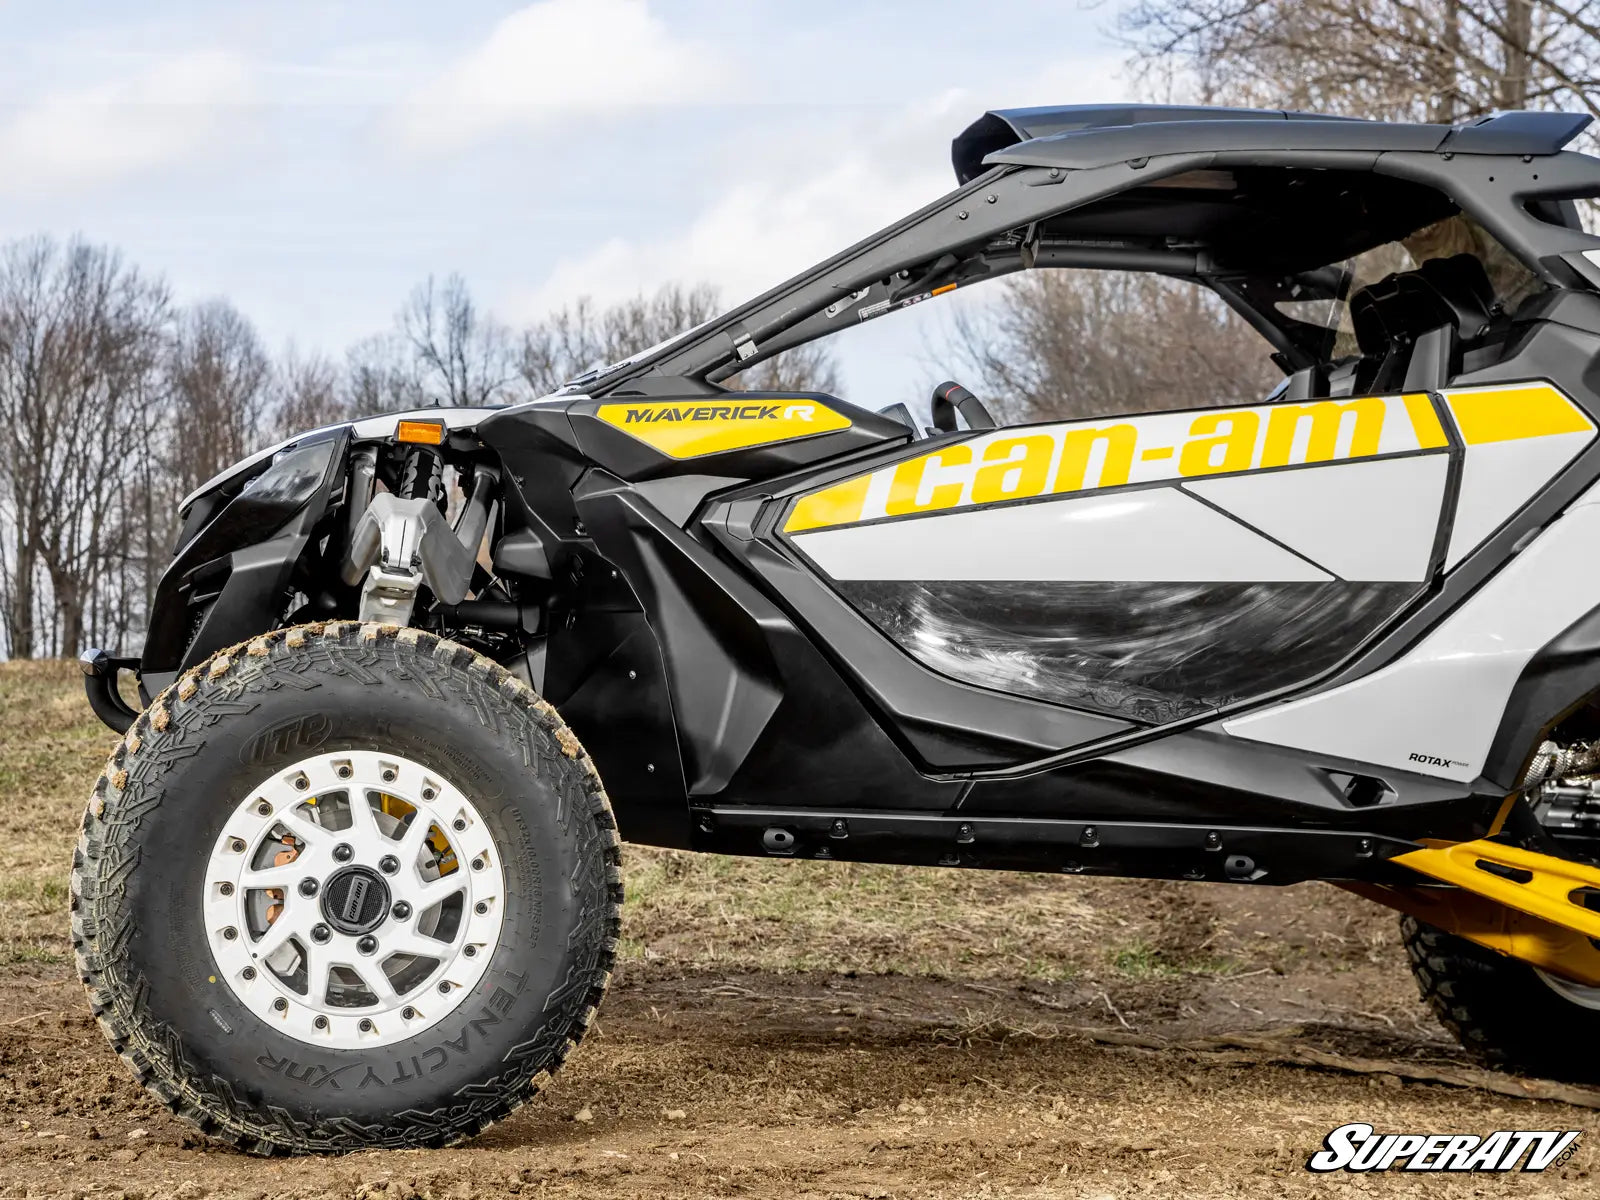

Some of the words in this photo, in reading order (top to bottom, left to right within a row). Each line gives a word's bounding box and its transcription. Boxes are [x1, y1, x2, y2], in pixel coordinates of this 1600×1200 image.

[625, 405, 783, 424] MAVERICK
[784, 405, 815, 421] R
[885, 396, 1387, 516] can-am
[250, 712, 328, 762] ITP
[1408, 753, 1452, 768] ROTAX
[348, 881, 364, 920] can-am
[357, 968, 529, 1089] TENACITY
